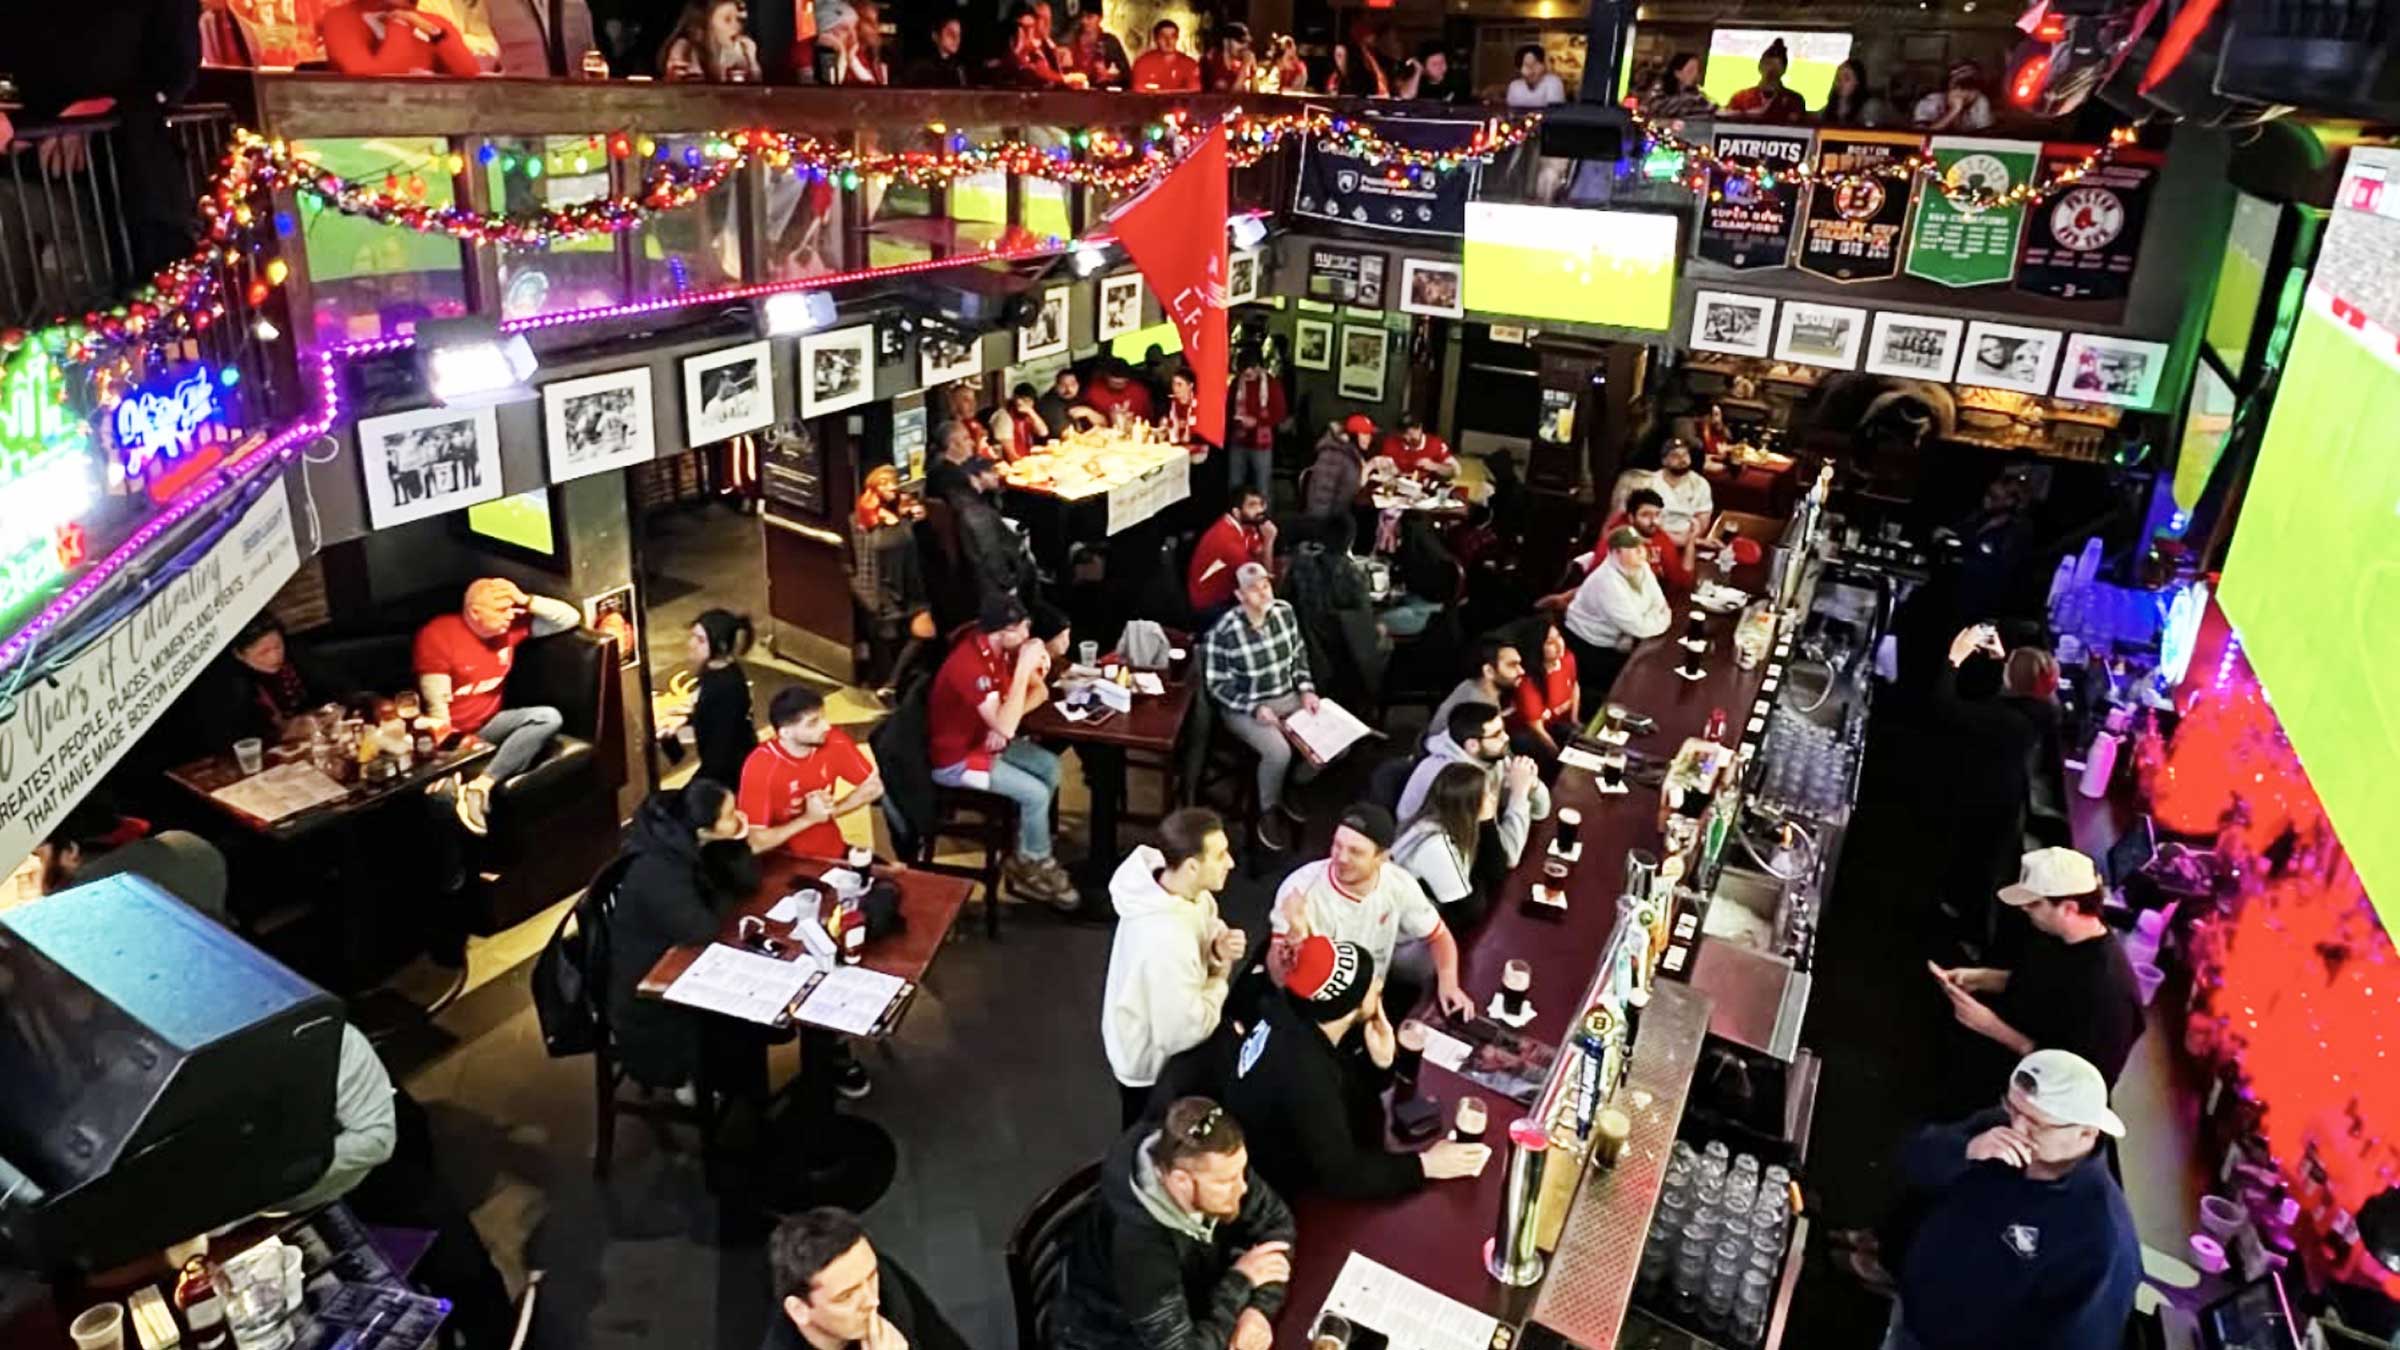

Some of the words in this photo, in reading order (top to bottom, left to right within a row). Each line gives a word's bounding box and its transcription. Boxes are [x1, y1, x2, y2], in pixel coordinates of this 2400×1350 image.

[1718, 138, 1802, 163] PATRIOTS
[1711, 206, 1749, 219] SUPER
[1752, 211, 1785, 223] BOWL
[1712, 219, 1780, 233] CHAMPIONS
[0, 754, 56, 829] REATEST
[151, 621, 197, 673] MOMENTS
[24, 671, 90, 754] Years
[24, 787, 59, 835] THAT
[59, 753, 94, 799] HAVE
[91, 721, 126, 763] MADE
[127, 681, 168, 730] BOSTON
